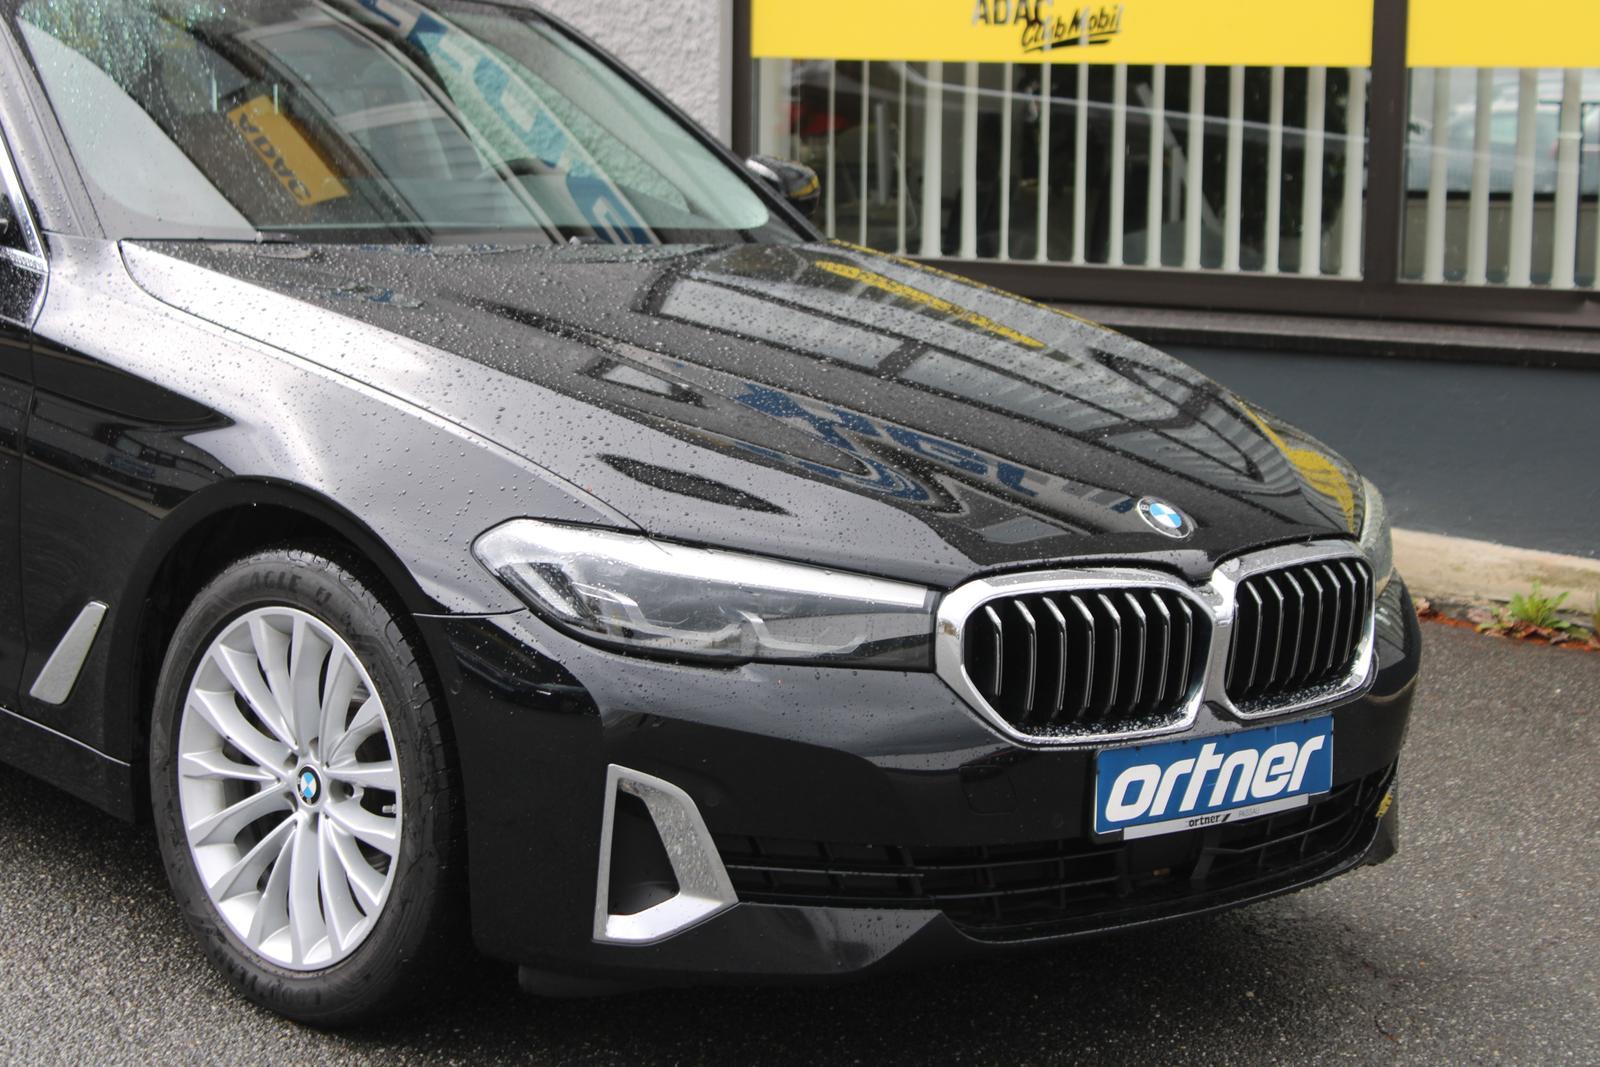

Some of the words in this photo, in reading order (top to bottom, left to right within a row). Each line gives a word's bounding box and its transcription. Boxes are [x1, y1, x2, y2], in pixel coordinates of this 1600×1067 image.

[972, 0, 1053, 26] ADAC
[1105, 735, 1326, 823] ortner
[1188, 814, 1222, 827] ortner
